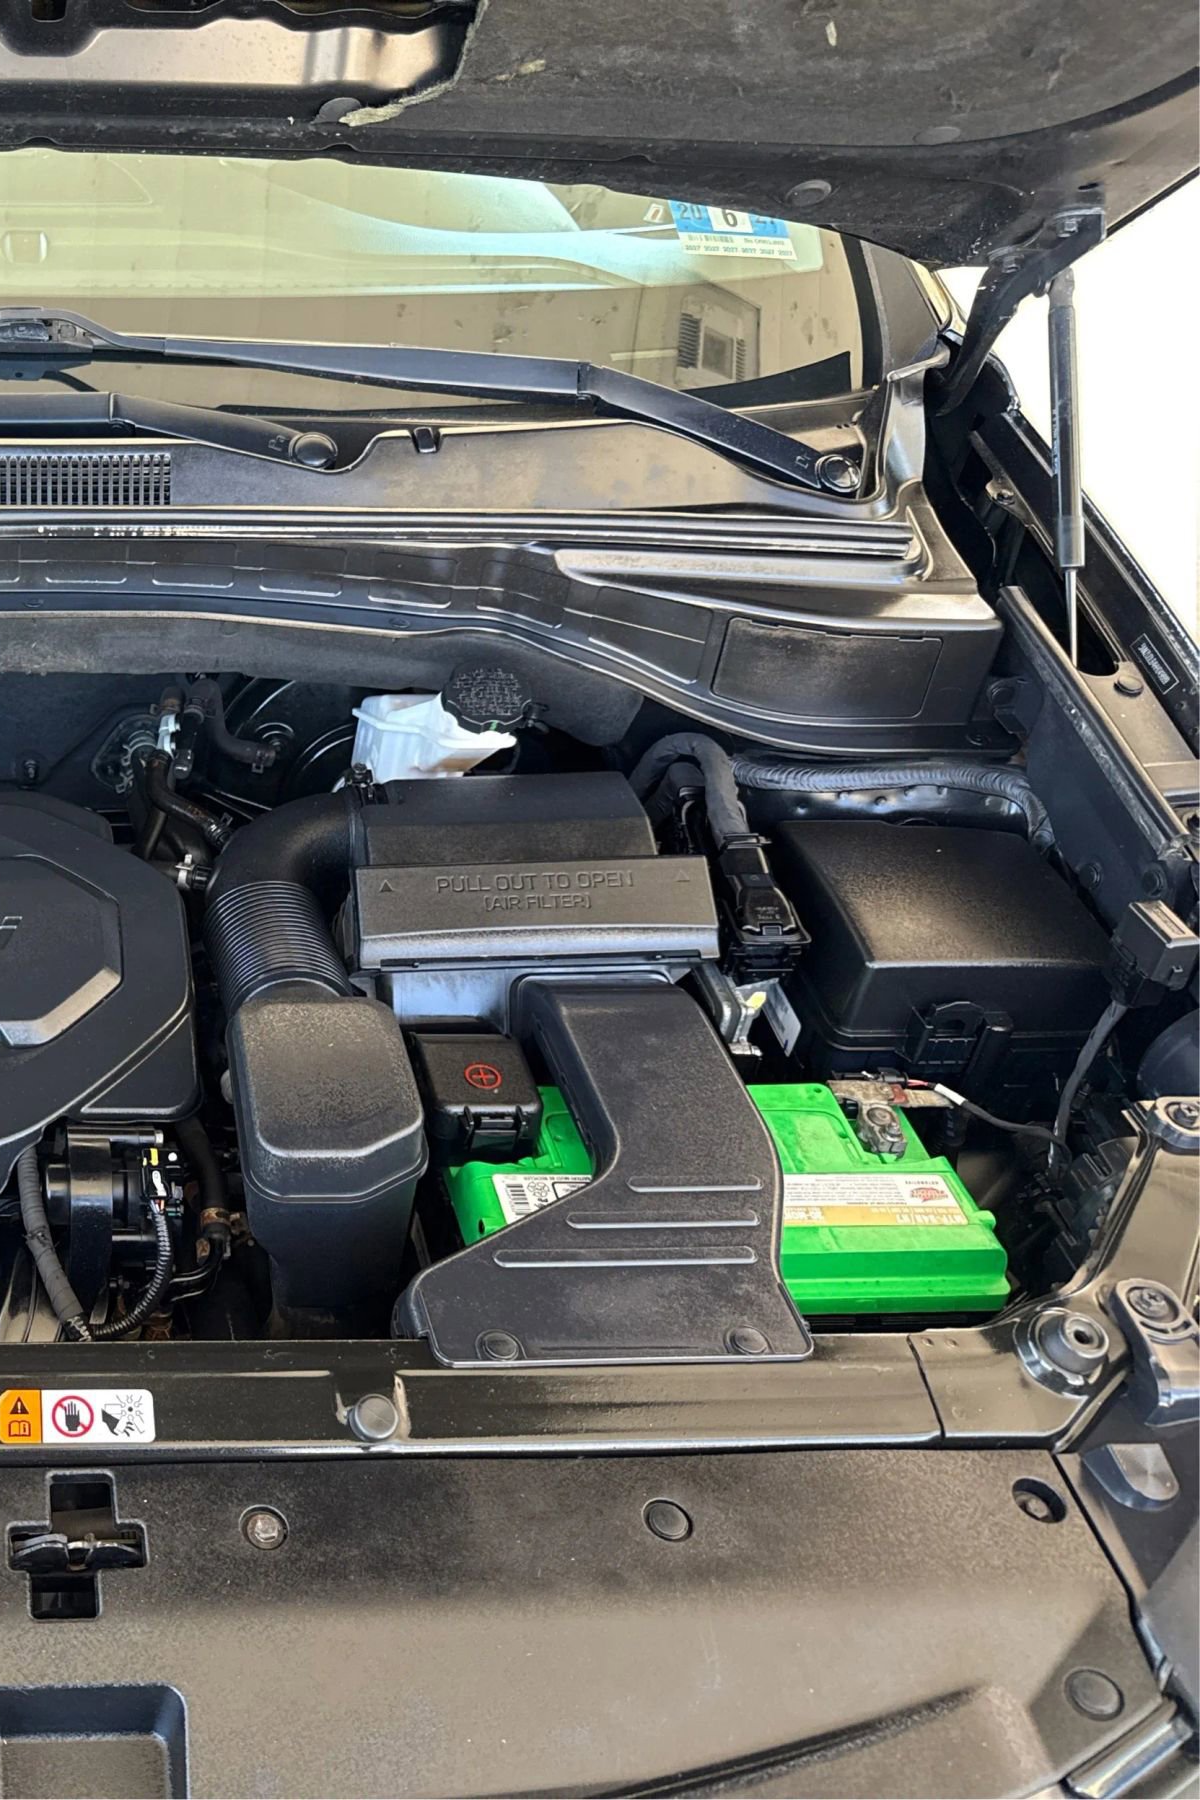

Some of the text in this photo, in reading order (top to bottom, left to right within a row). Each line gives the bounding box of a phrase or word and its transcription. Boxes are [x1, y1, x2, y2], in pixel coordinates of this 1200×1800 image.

[677, 203, 704, 221] 20
[721, 208, 739, 228] 6
[435, 870, 634, 893] PULL OUT TO OPEN
